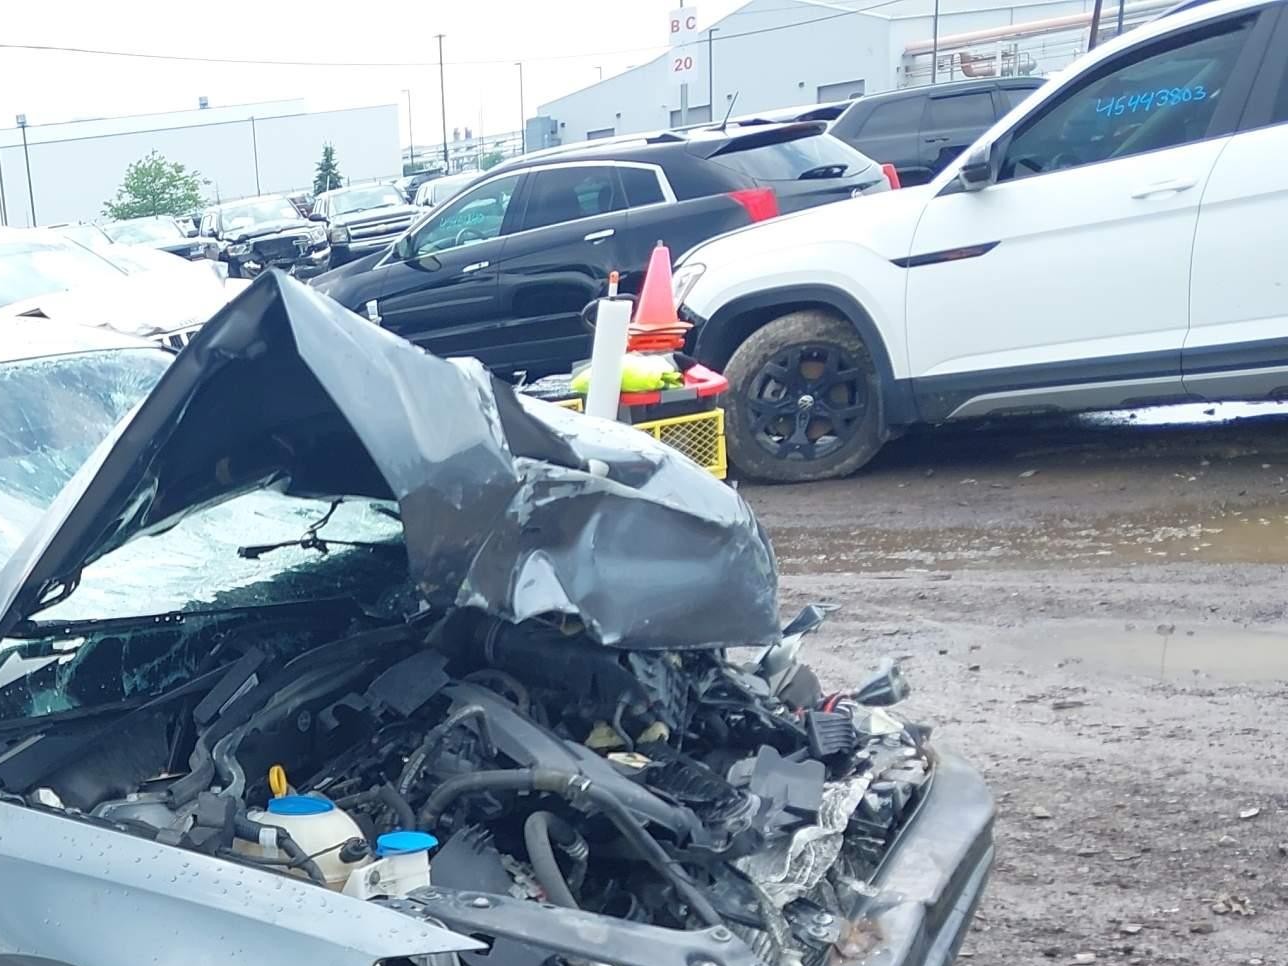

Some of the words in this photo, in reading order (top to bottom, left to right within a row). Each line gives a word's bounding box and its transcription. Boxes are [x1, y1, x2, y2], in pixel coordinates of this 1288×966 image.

[671, 19, 680, 33] B
[686, 16, 696, 30] C
[674, 56, 693, 72] 20
